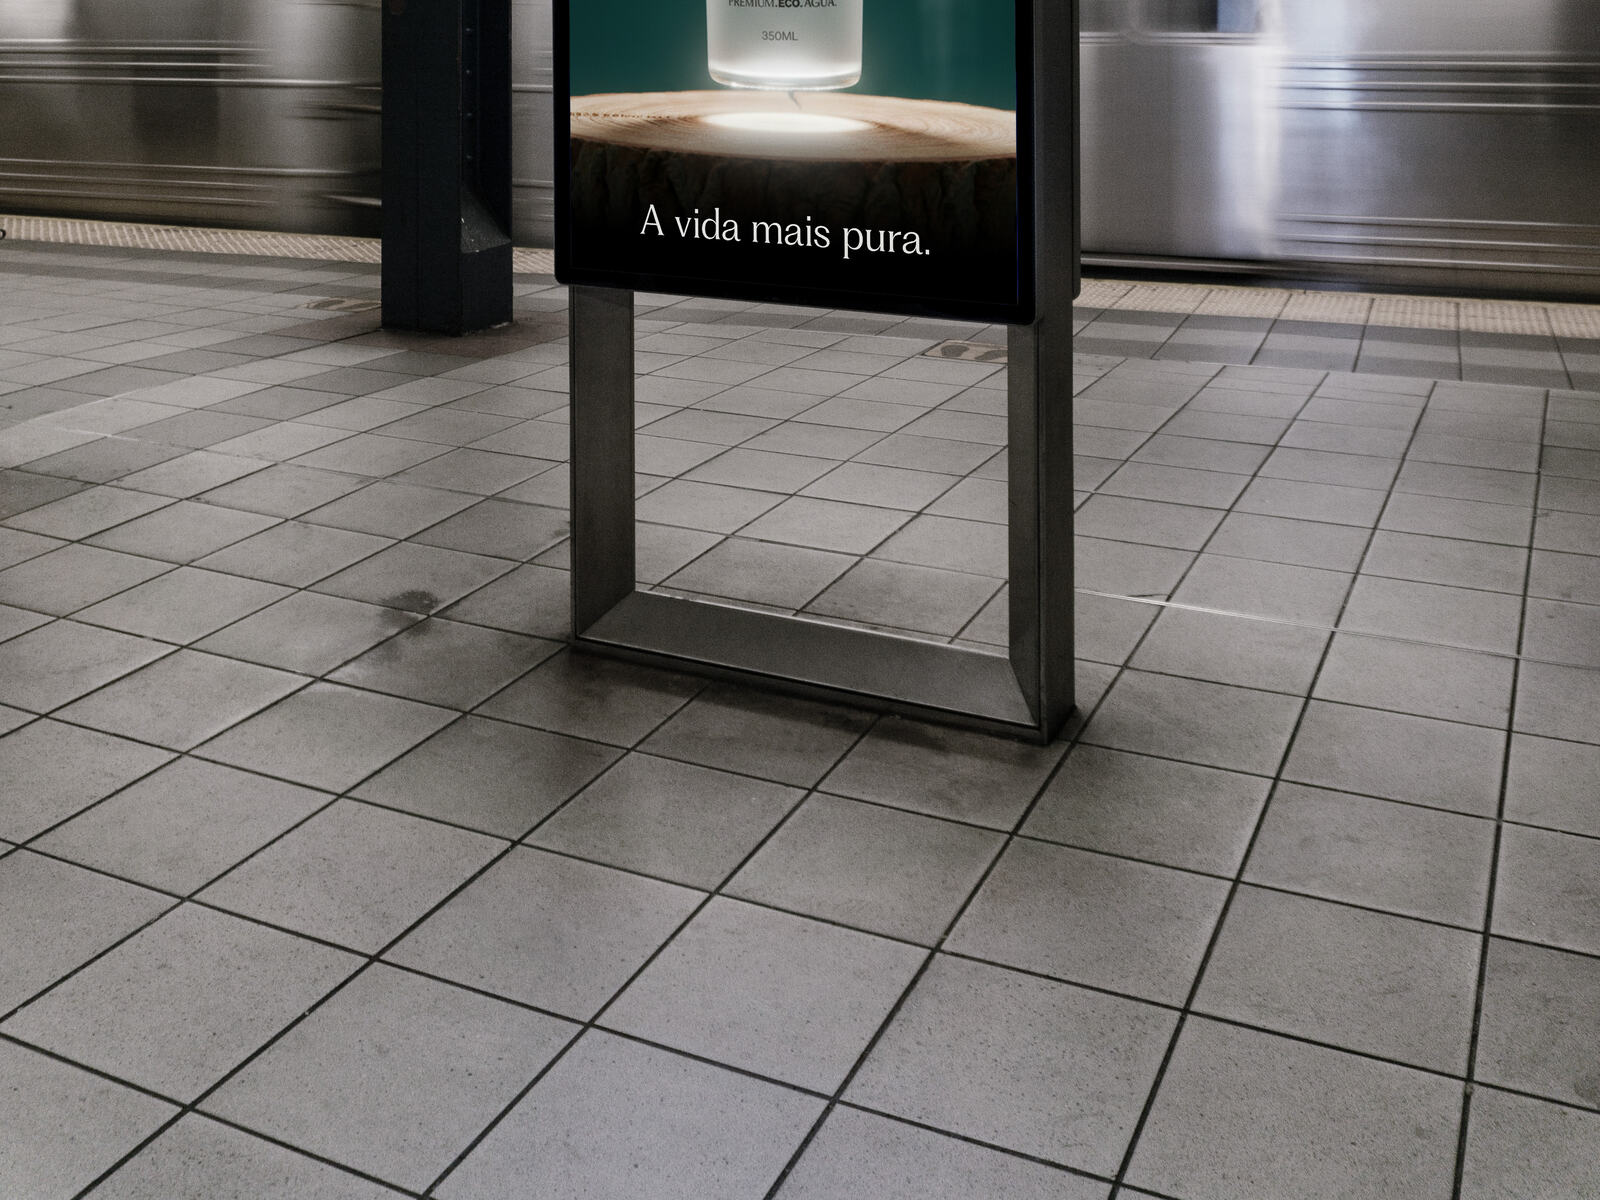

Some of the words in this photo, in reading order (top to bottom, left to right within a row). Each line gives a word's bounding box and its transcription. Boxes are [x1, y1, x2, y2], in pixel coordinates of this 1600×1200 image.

[761, 30, 799, 41] 350ML
[640, 203, 665, 236] A
[674, 207, 741, 242] vida
[752, 215, 831, 248] mais
[842, 227, 930, 259] pura.
